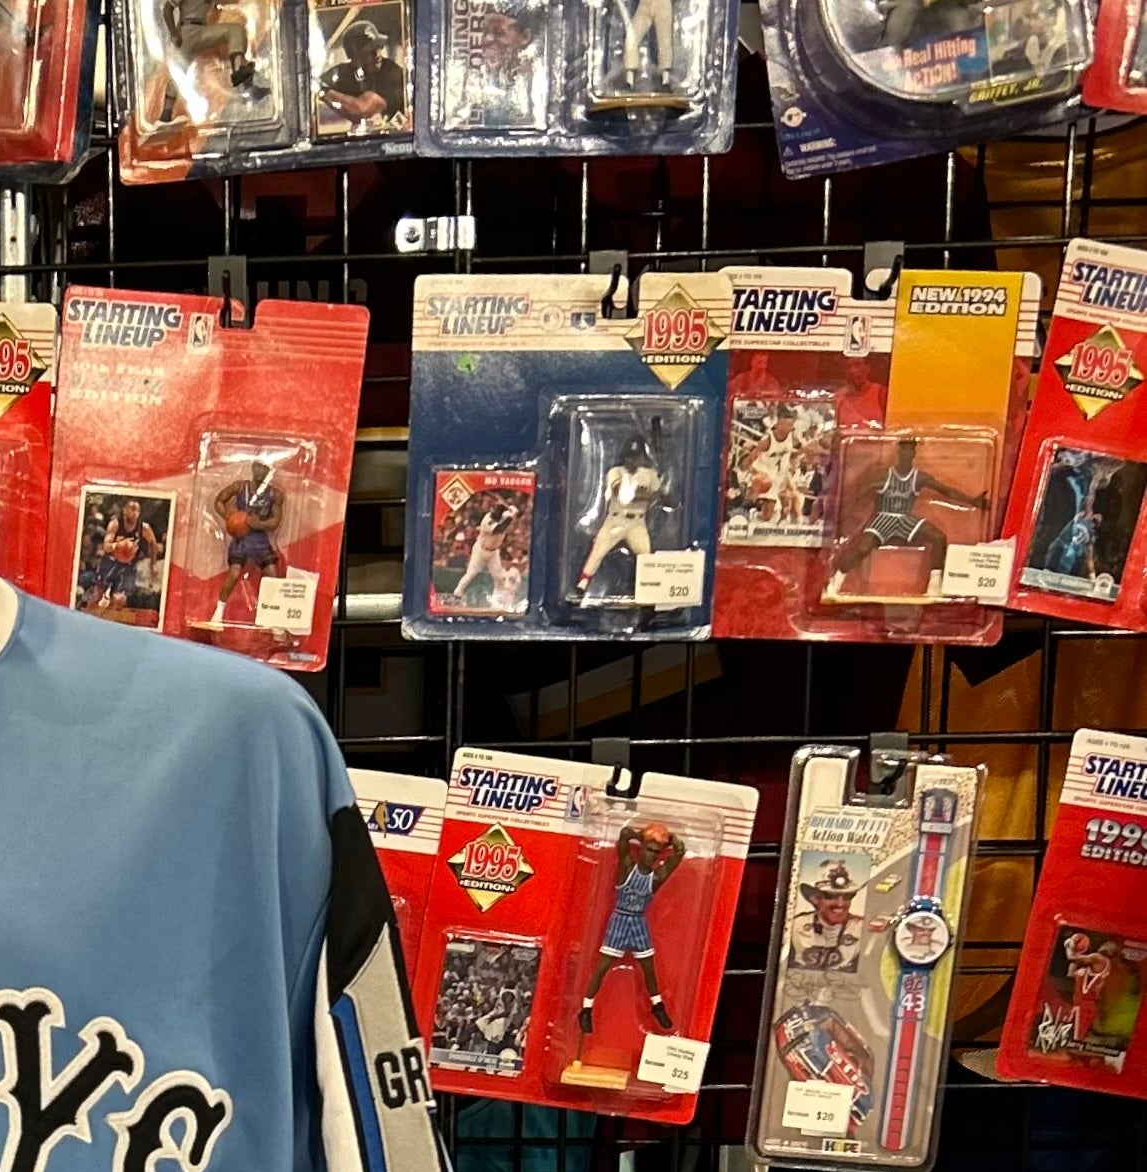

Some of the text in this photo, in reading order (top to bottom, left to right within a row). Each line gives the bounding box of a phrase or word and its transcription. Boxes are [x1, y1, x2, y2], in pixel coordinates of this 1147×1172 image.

[902, 36, 976, 67] Real Hitting
[912, 287, 1007, 302] NEW 1994
[68, 300, 181, 328] STARTING
[427, 295, 530, 316] STARTING
[910, 301, 1006, 315] EDITION
[441, 315, 516, 336] LINEUP
[642, 308, 707, 354] 1995
[733, 310, 820, 333] LINEUP
[82, 322, 165, 349] LINEUP
[648, 354, 701, 364] EDITION
[1068, 342, 1132, 388] 1995
[1068, 383, 1120, 400] EDITION
[669, 585, 689, 598] $20
[978, 576, 996, 588] $20
[286, 608, 302, 620] $20
[459, 767, 558, 796] STARTING
[471, 787, 544, 812] LINEUP
[387, 808, 415, 830] 50
[809, 815, 890, 833] RICHARD PETTY
[809, 828, 880, 846] Action Watch
[464, 839, 522, 882] 1995
[461, 880, 512, 892] EDITION
[901, 992, 926, 1013] 43
[671, 1067, 690, 1081] $25
[816, 1110, 835, 1123] $20
